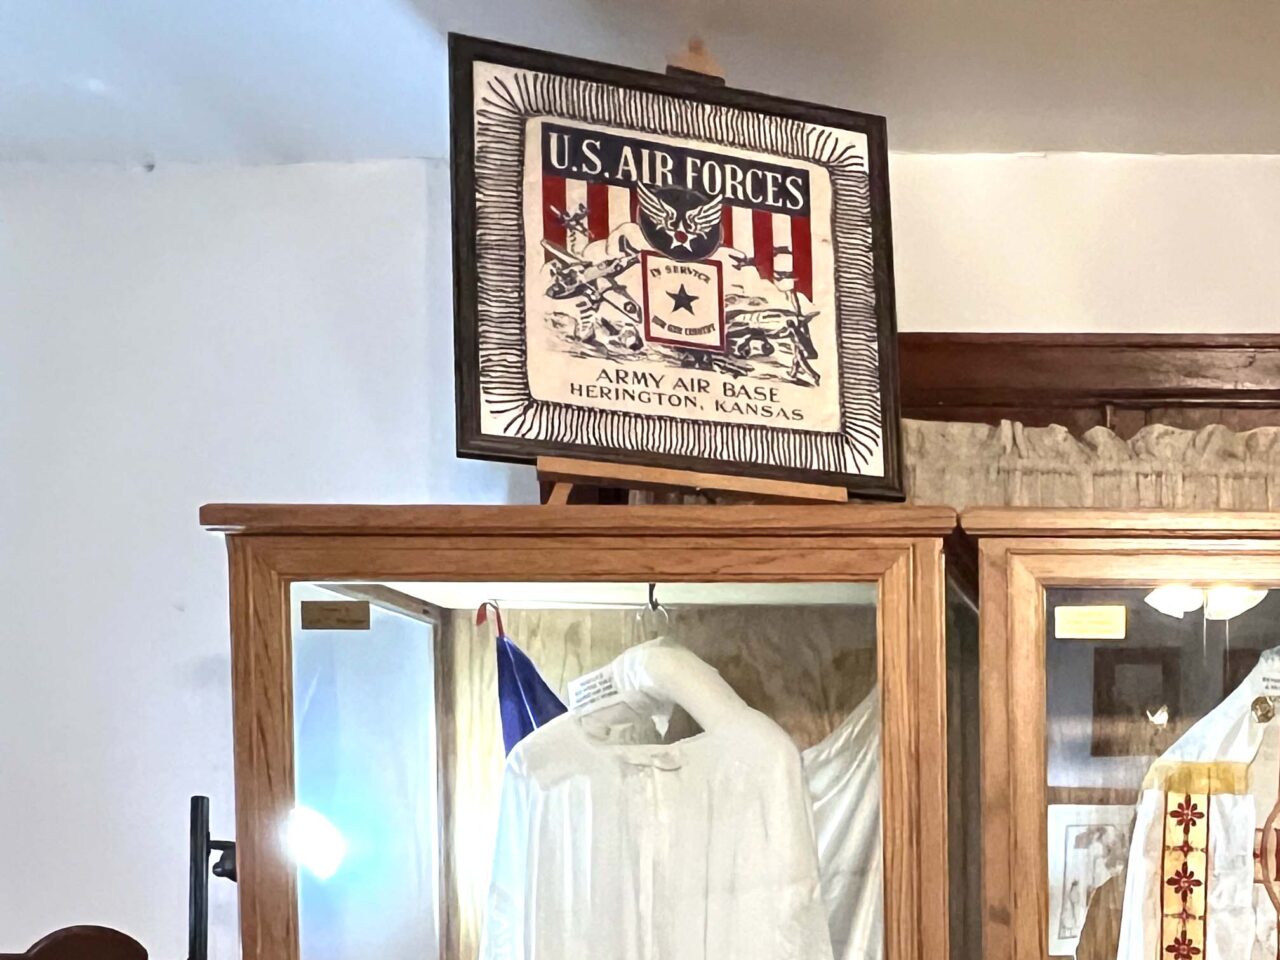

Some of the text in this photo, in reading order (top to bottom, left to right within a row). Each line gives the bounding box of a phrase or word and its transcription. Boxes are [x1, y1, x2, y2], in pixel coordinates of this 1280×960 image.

[548, 132, 804, 210] U.S. AIR FORCES
[570, 382, 804, 421] HERINGTON, KANSAS
[596, 368, 781, 403] ARMY AIR BASE
